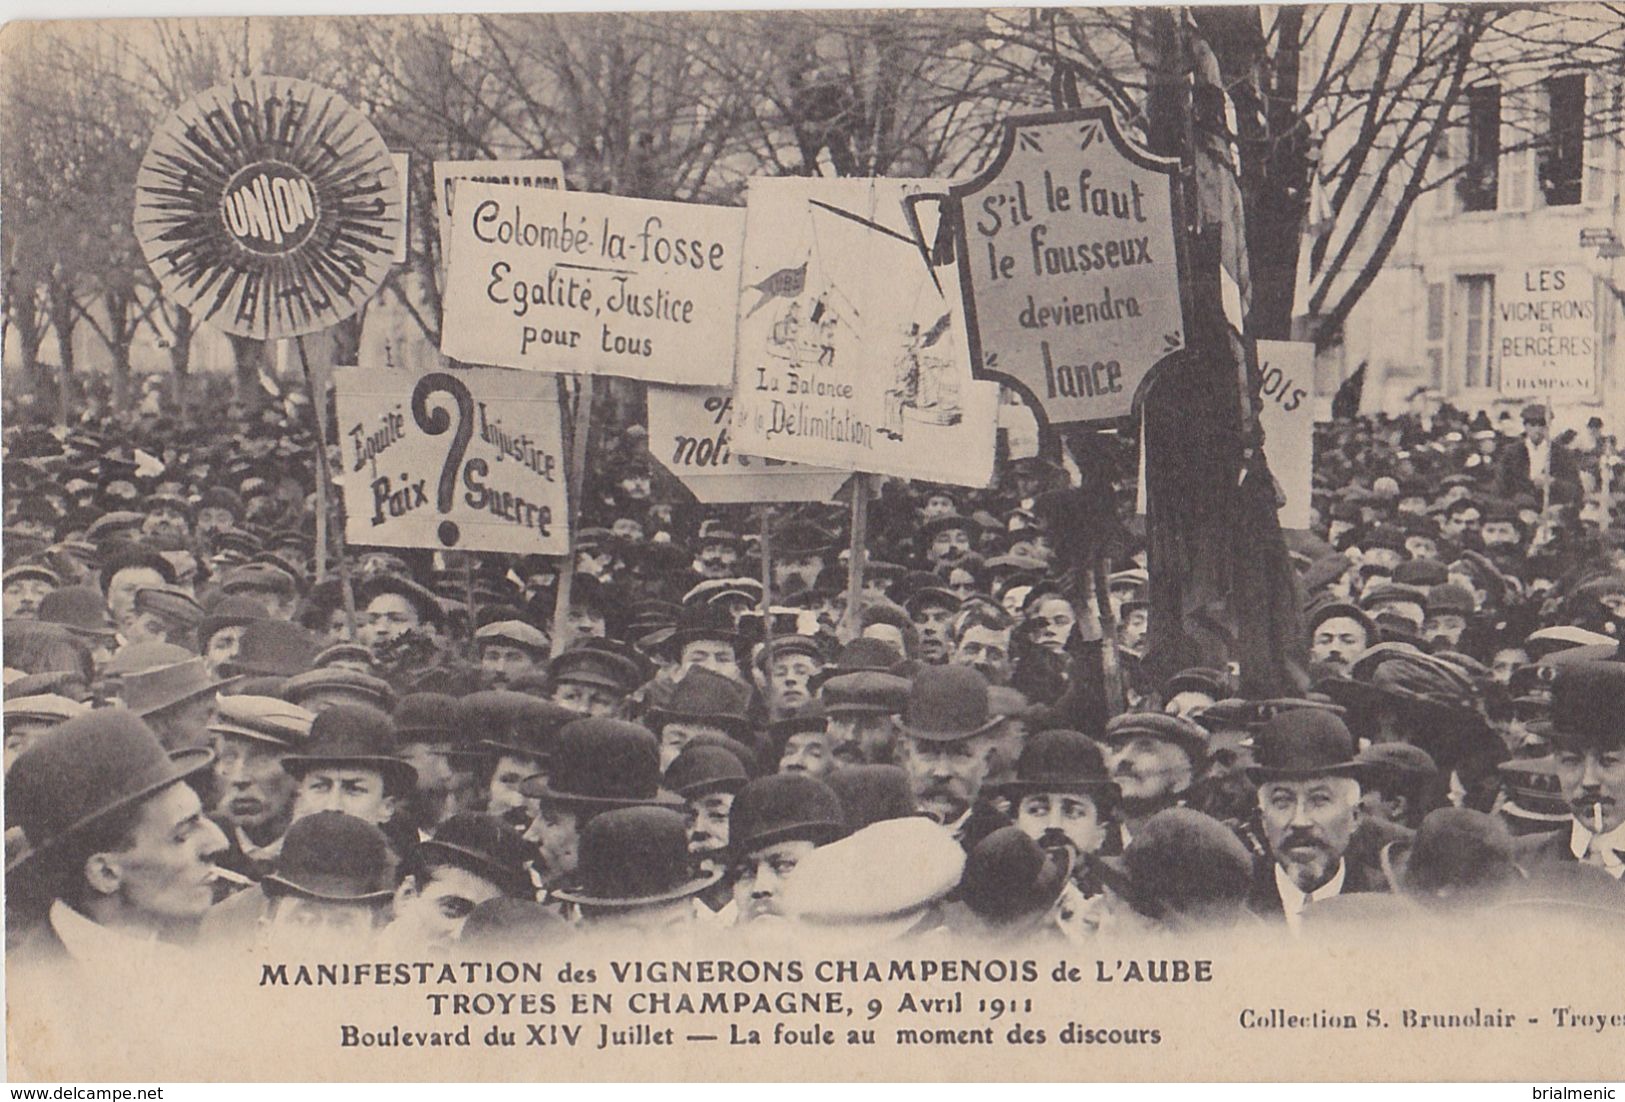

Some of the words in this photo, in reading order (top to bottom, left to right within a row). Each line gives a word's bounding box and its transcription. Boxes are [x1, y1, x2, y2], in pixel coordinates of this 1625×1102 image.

[226, 174, 315, 244] UNION
[977, 180, 1033, 237] S'il
[1044, 169, 1070, 212] le
[1079, 168, 1147, 222] faut
[988, 242, 1016, 280] le
[1525, 270, 1566, 292] LES
[487, 261, 601, 318] Egalité,
[606, 276, 694, 324] Justice
[1018, 286, 1142, 329] deviendra
[1500, 301, 1593, 322] VIGNERONS
[521, 326, 582, 355] pour
[602, 323, 653, 357] tous
[756, 367, 780, 392] La
[787, 371, 853, 399] Balance
[1040, 340, 1123, 399] lance
[349, 404, 405, 479] Equité
[411, 372, 474, 548] ?
[478, 402, 555, 482] Injustice
[371, 472, 429, 527] Paix
